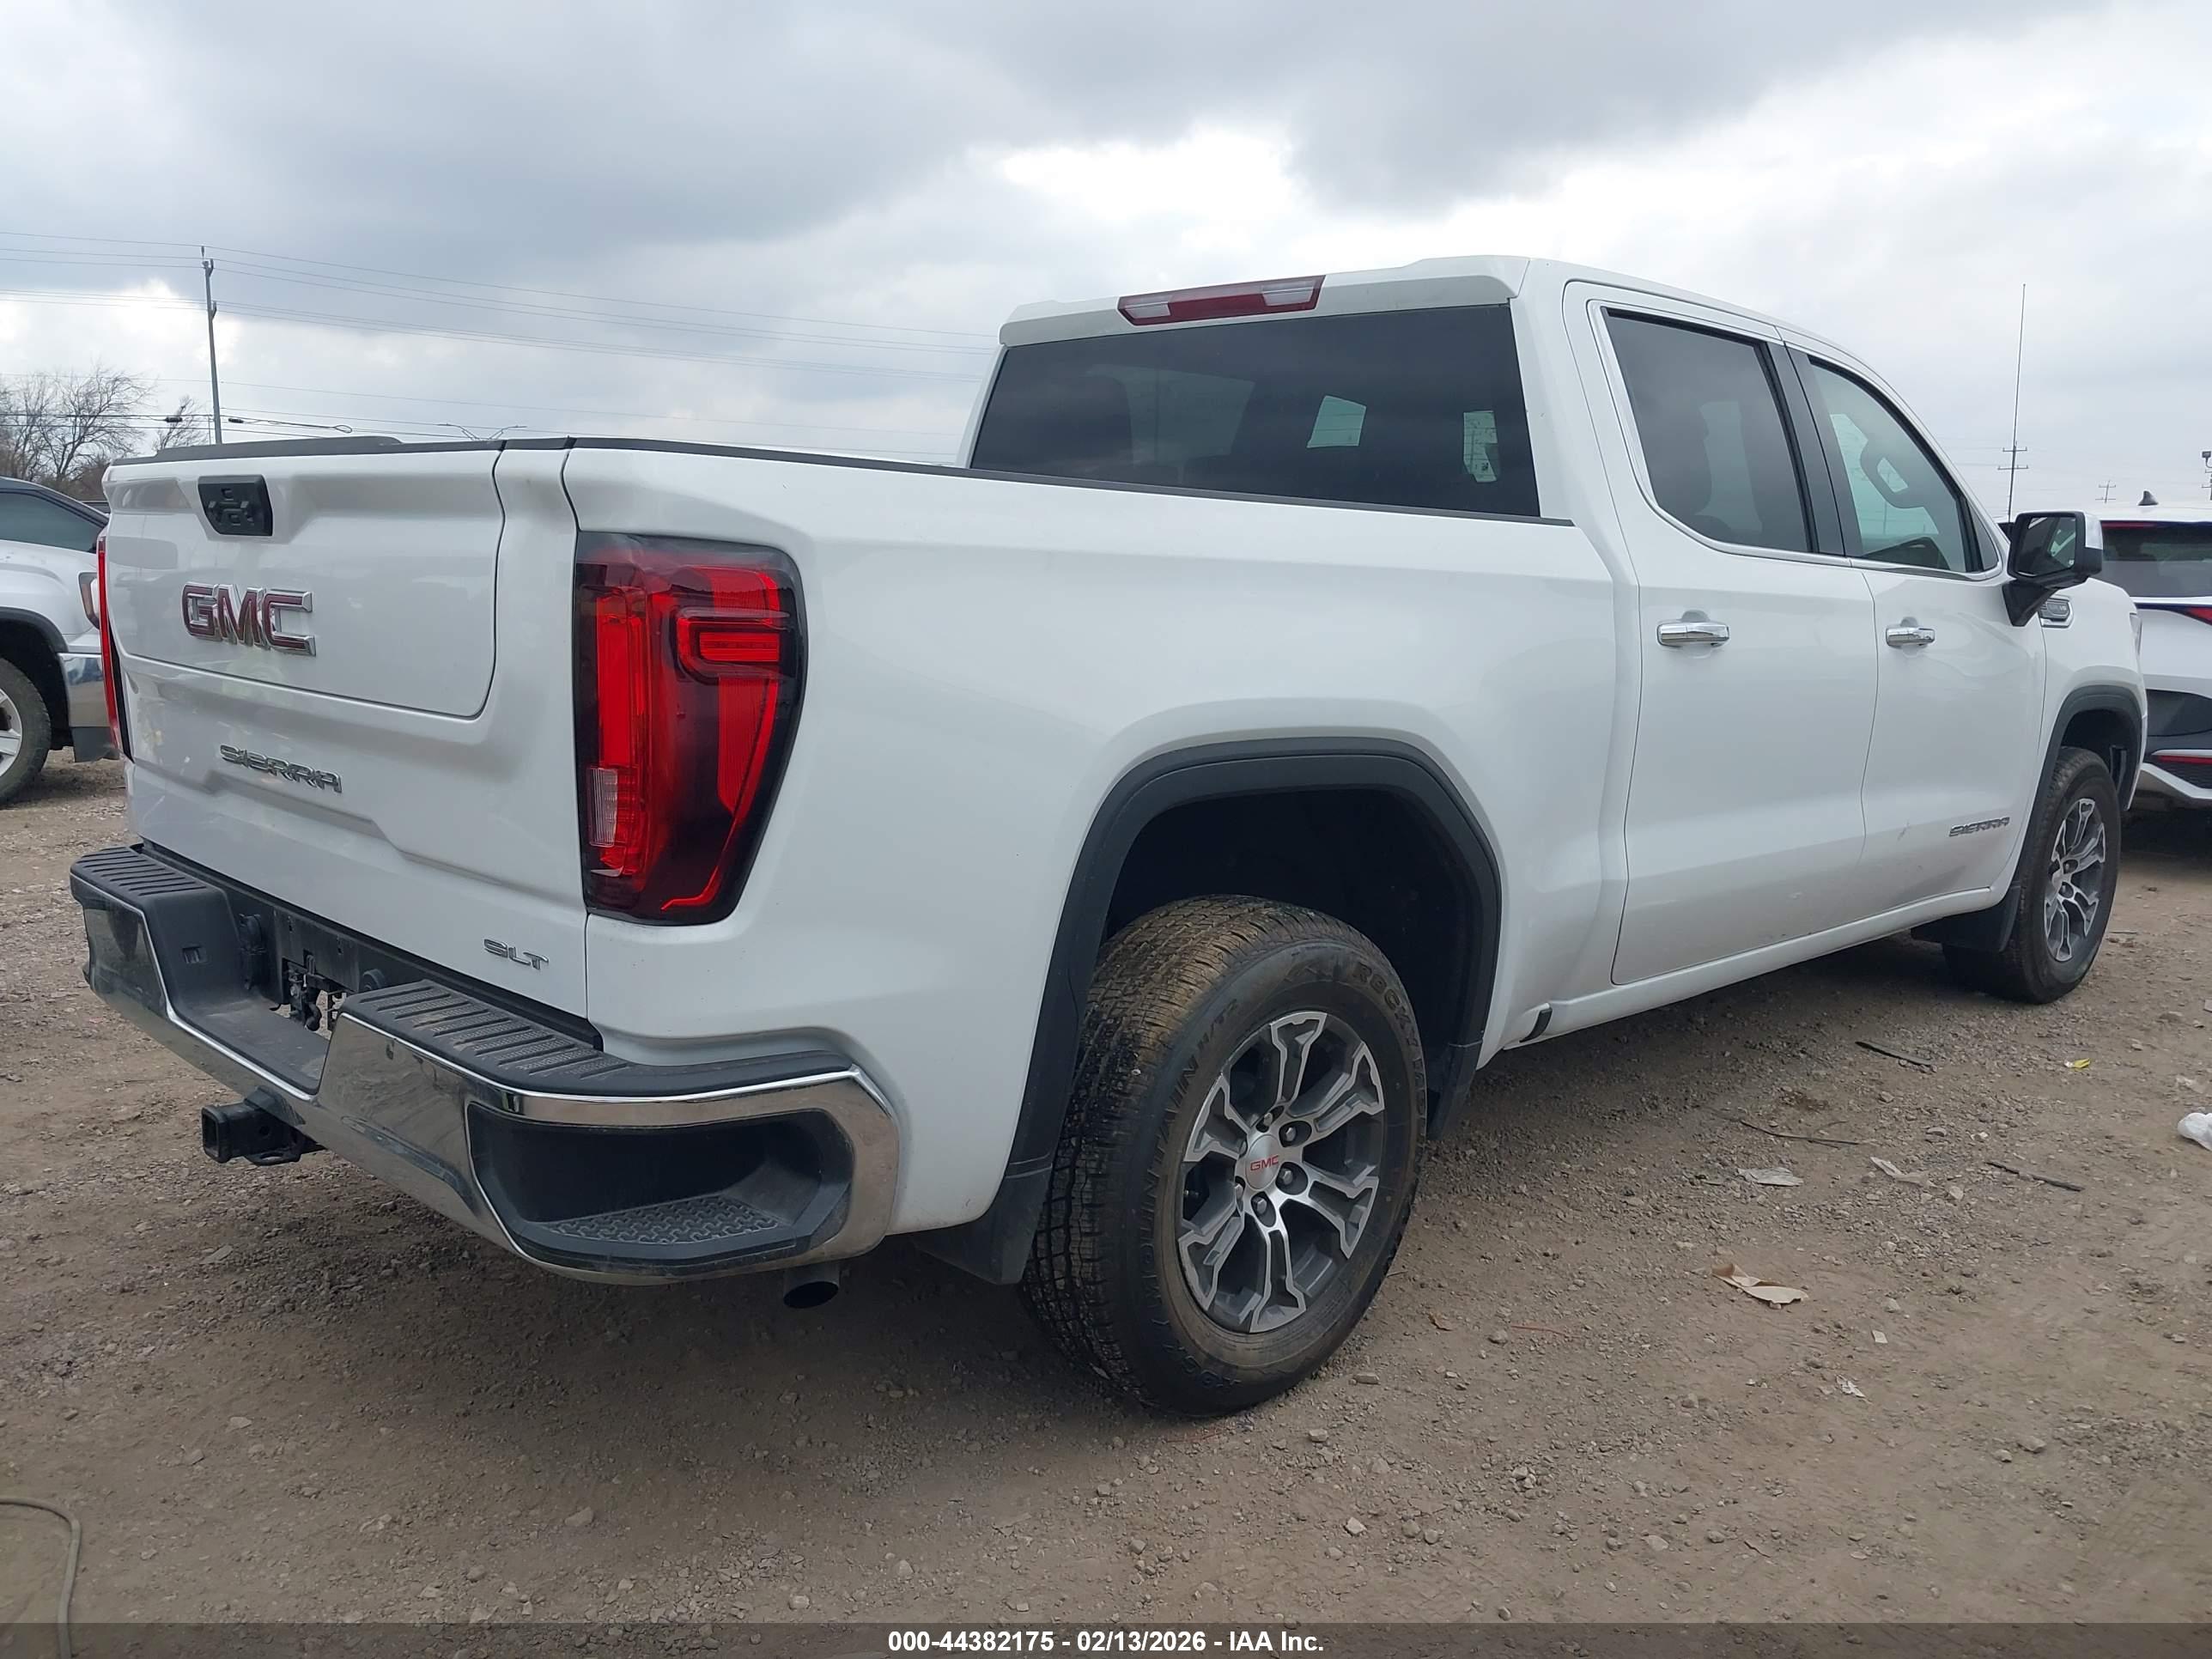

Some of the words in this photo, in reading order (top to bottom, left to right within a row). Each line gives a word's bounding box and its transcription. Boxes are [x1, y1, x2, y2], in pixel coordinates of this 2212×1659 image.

[181, 581, 316, 656] GMC
[220, 744, 342, 793] SIERRA
[1948, 817, 2010, 837] SIERRA
[483, 939, 550, 970] SLT
[1352, 959, 1420, 1048] ROCKY
[1250, 1155, 1279, 1171] GMC
